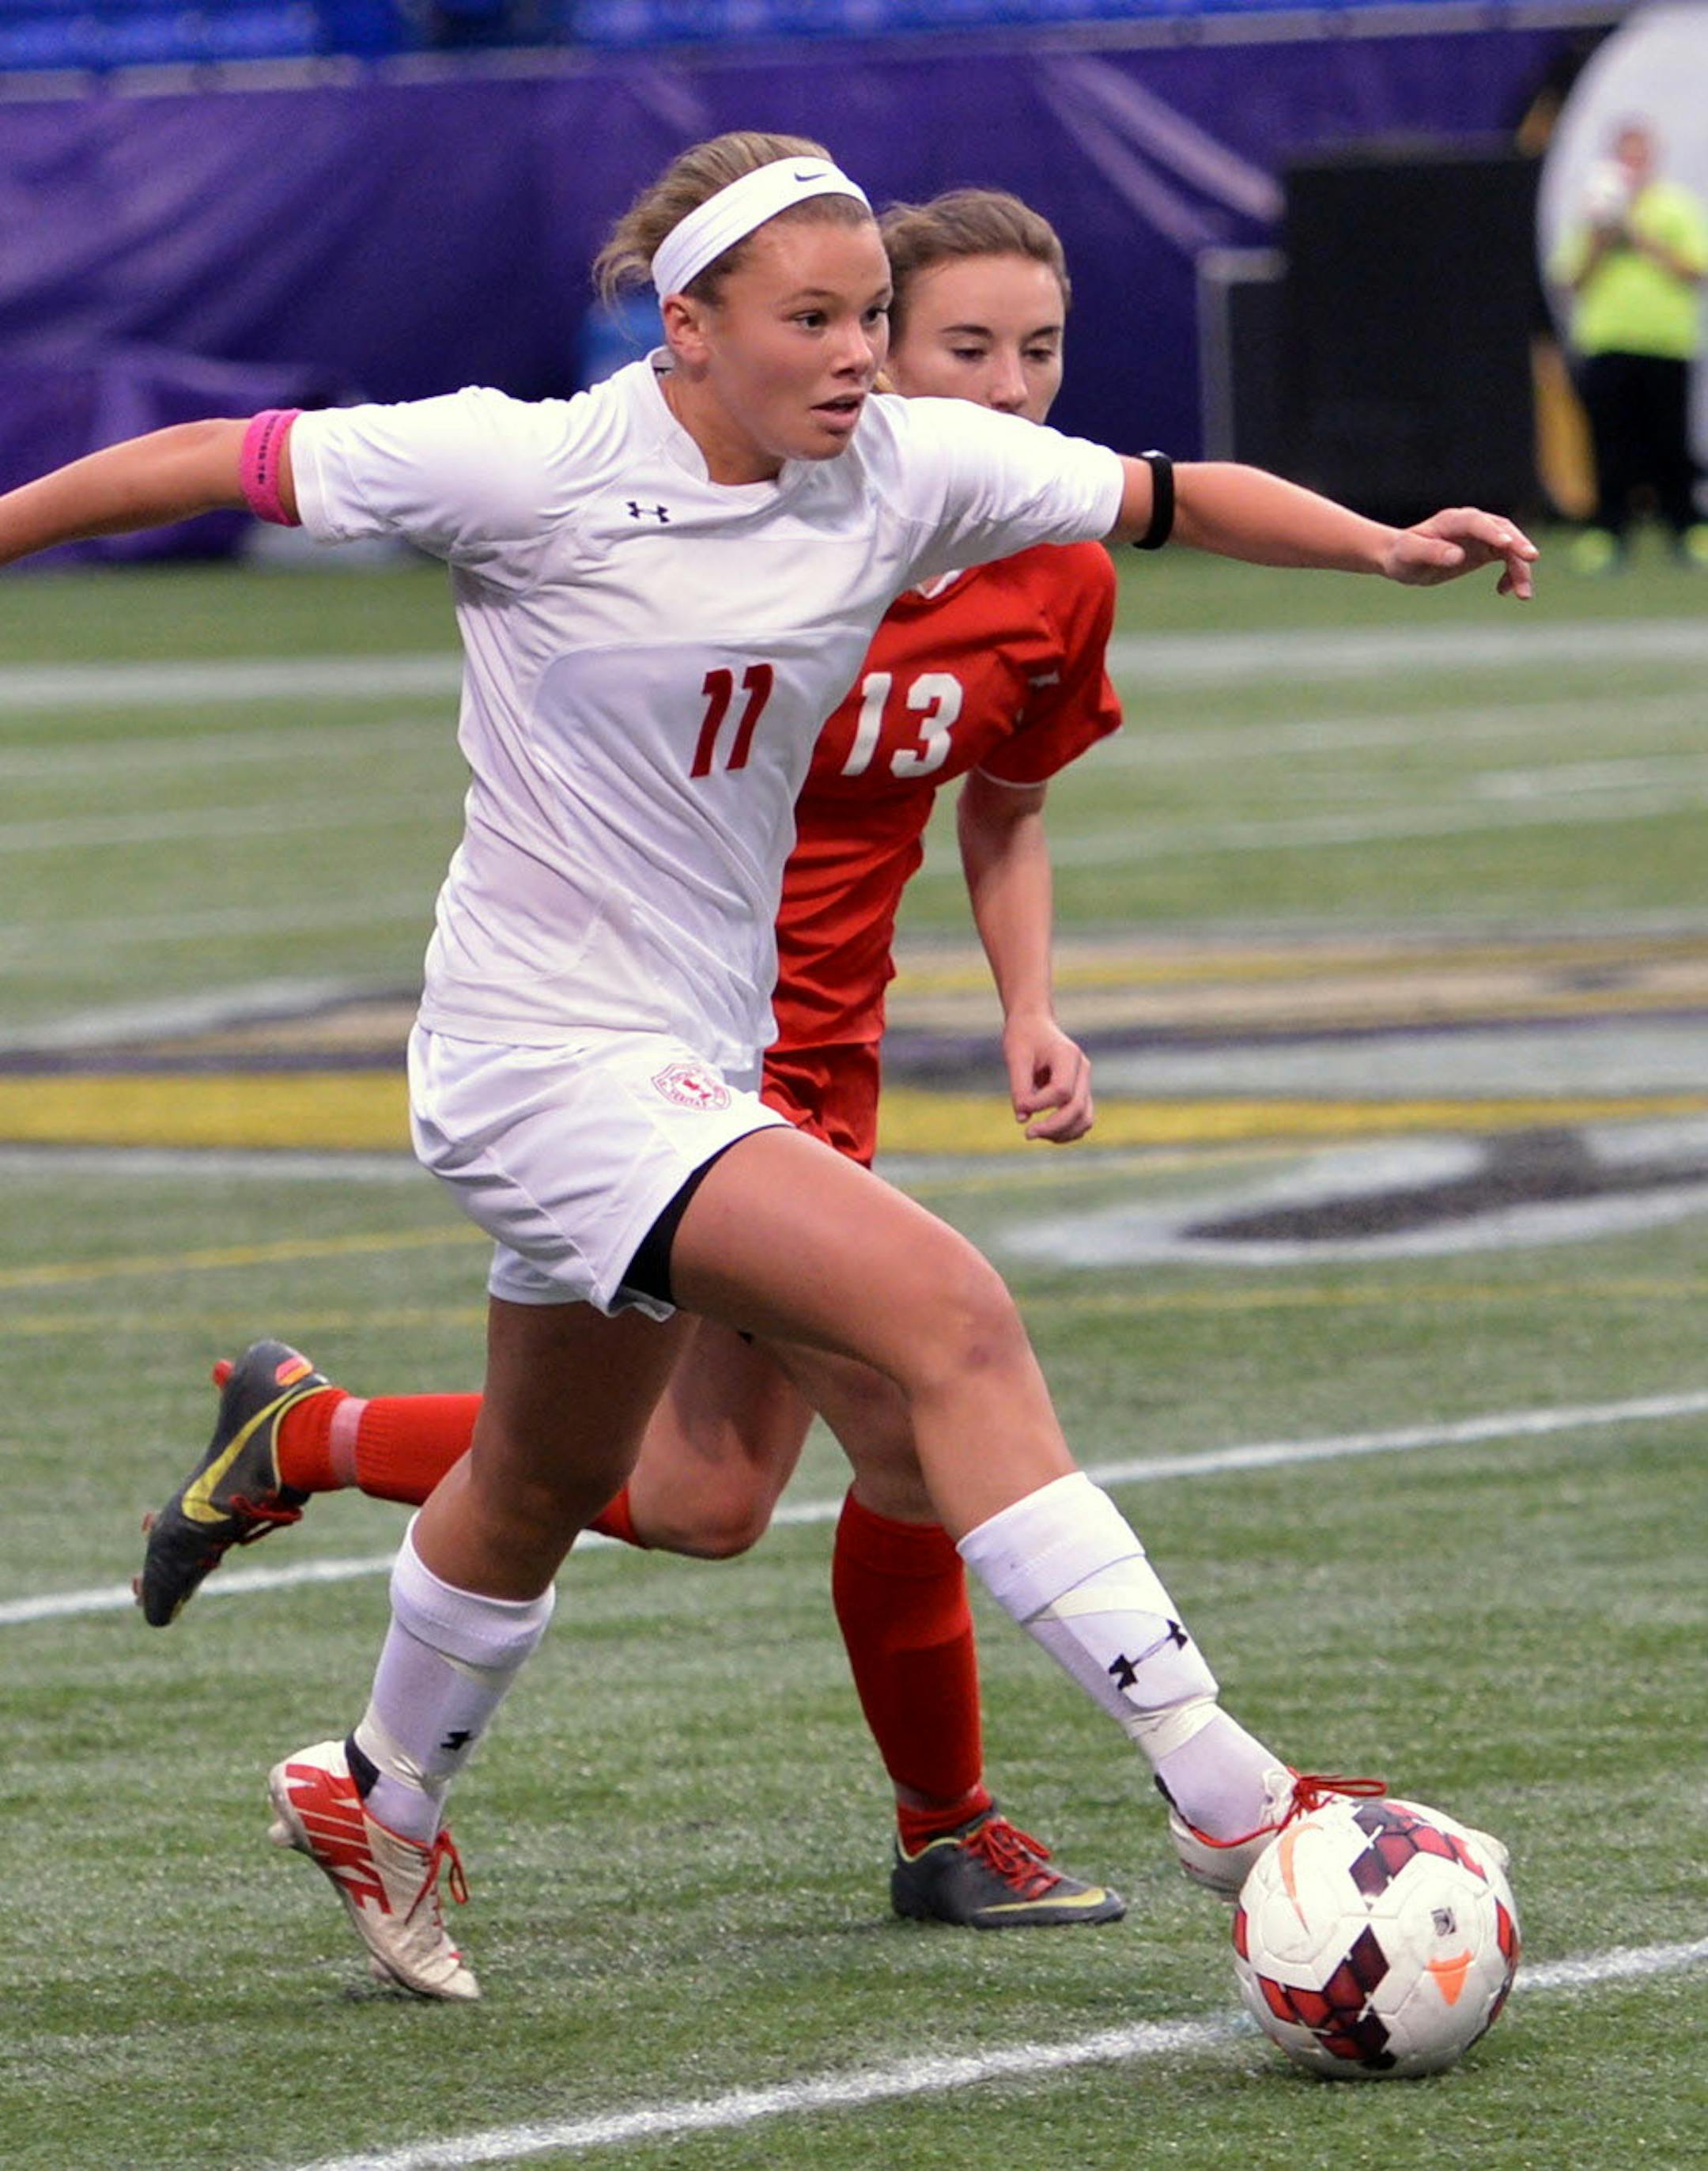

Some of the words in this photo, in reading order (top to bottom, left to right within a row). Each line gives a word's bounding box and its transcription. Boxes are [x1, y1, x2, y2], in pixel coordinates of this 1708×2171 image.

[690, 664, 773, 778] 11
[841, 671, 963, 778] 13
[285, 1764, 392, 1914] NIKE
